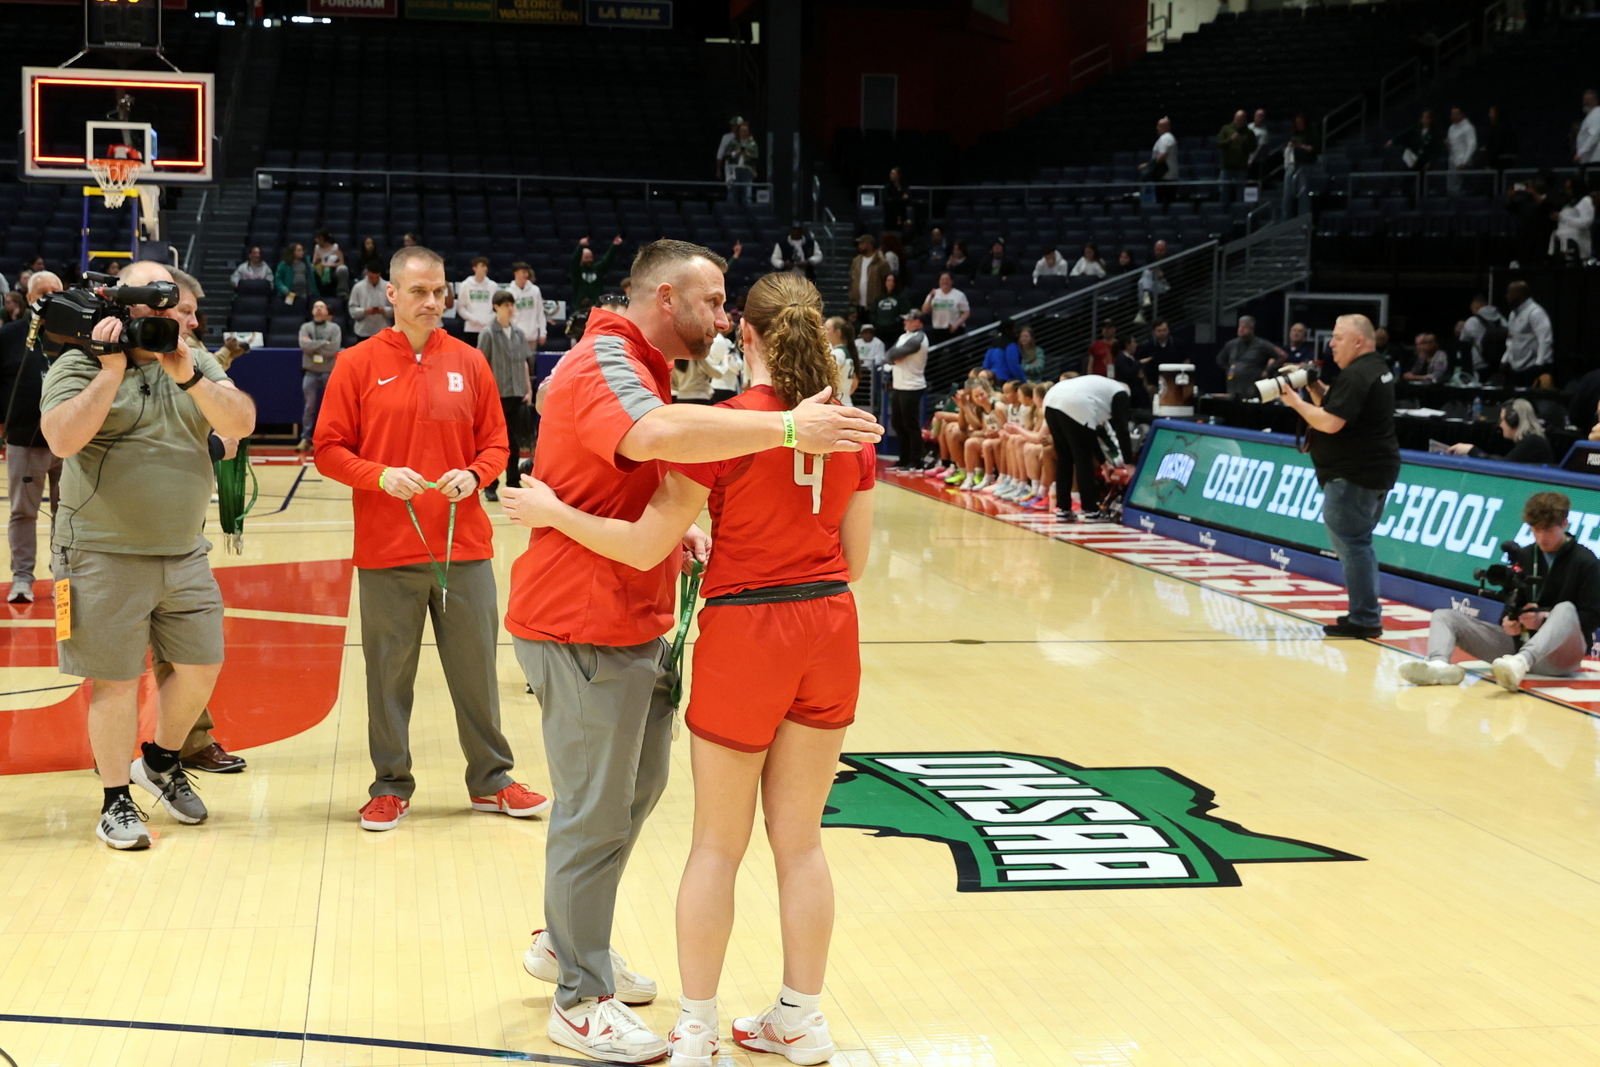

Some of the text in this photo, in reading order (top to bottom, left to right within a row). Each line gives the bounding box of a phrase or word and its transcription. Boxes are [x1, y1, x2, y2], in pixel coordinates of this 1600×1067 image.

[320, 0, 385, 9] FORDHAM
[513, 0, 563, 9] GEORGE
[599, 6, 660, 21] LA SALLE
[499, 8, 579, 21] WASHINGTON
[446, 371, 464, 392] B
[1155, 453, 1196, 487] OHSAA
[1202, 454, 1275, 510] OHIO
[1266, 464, 1325, 524] HIG
[1372, 482, 1503, 559] CHOOL
[873, 756, 1191, 881] OHSAA
